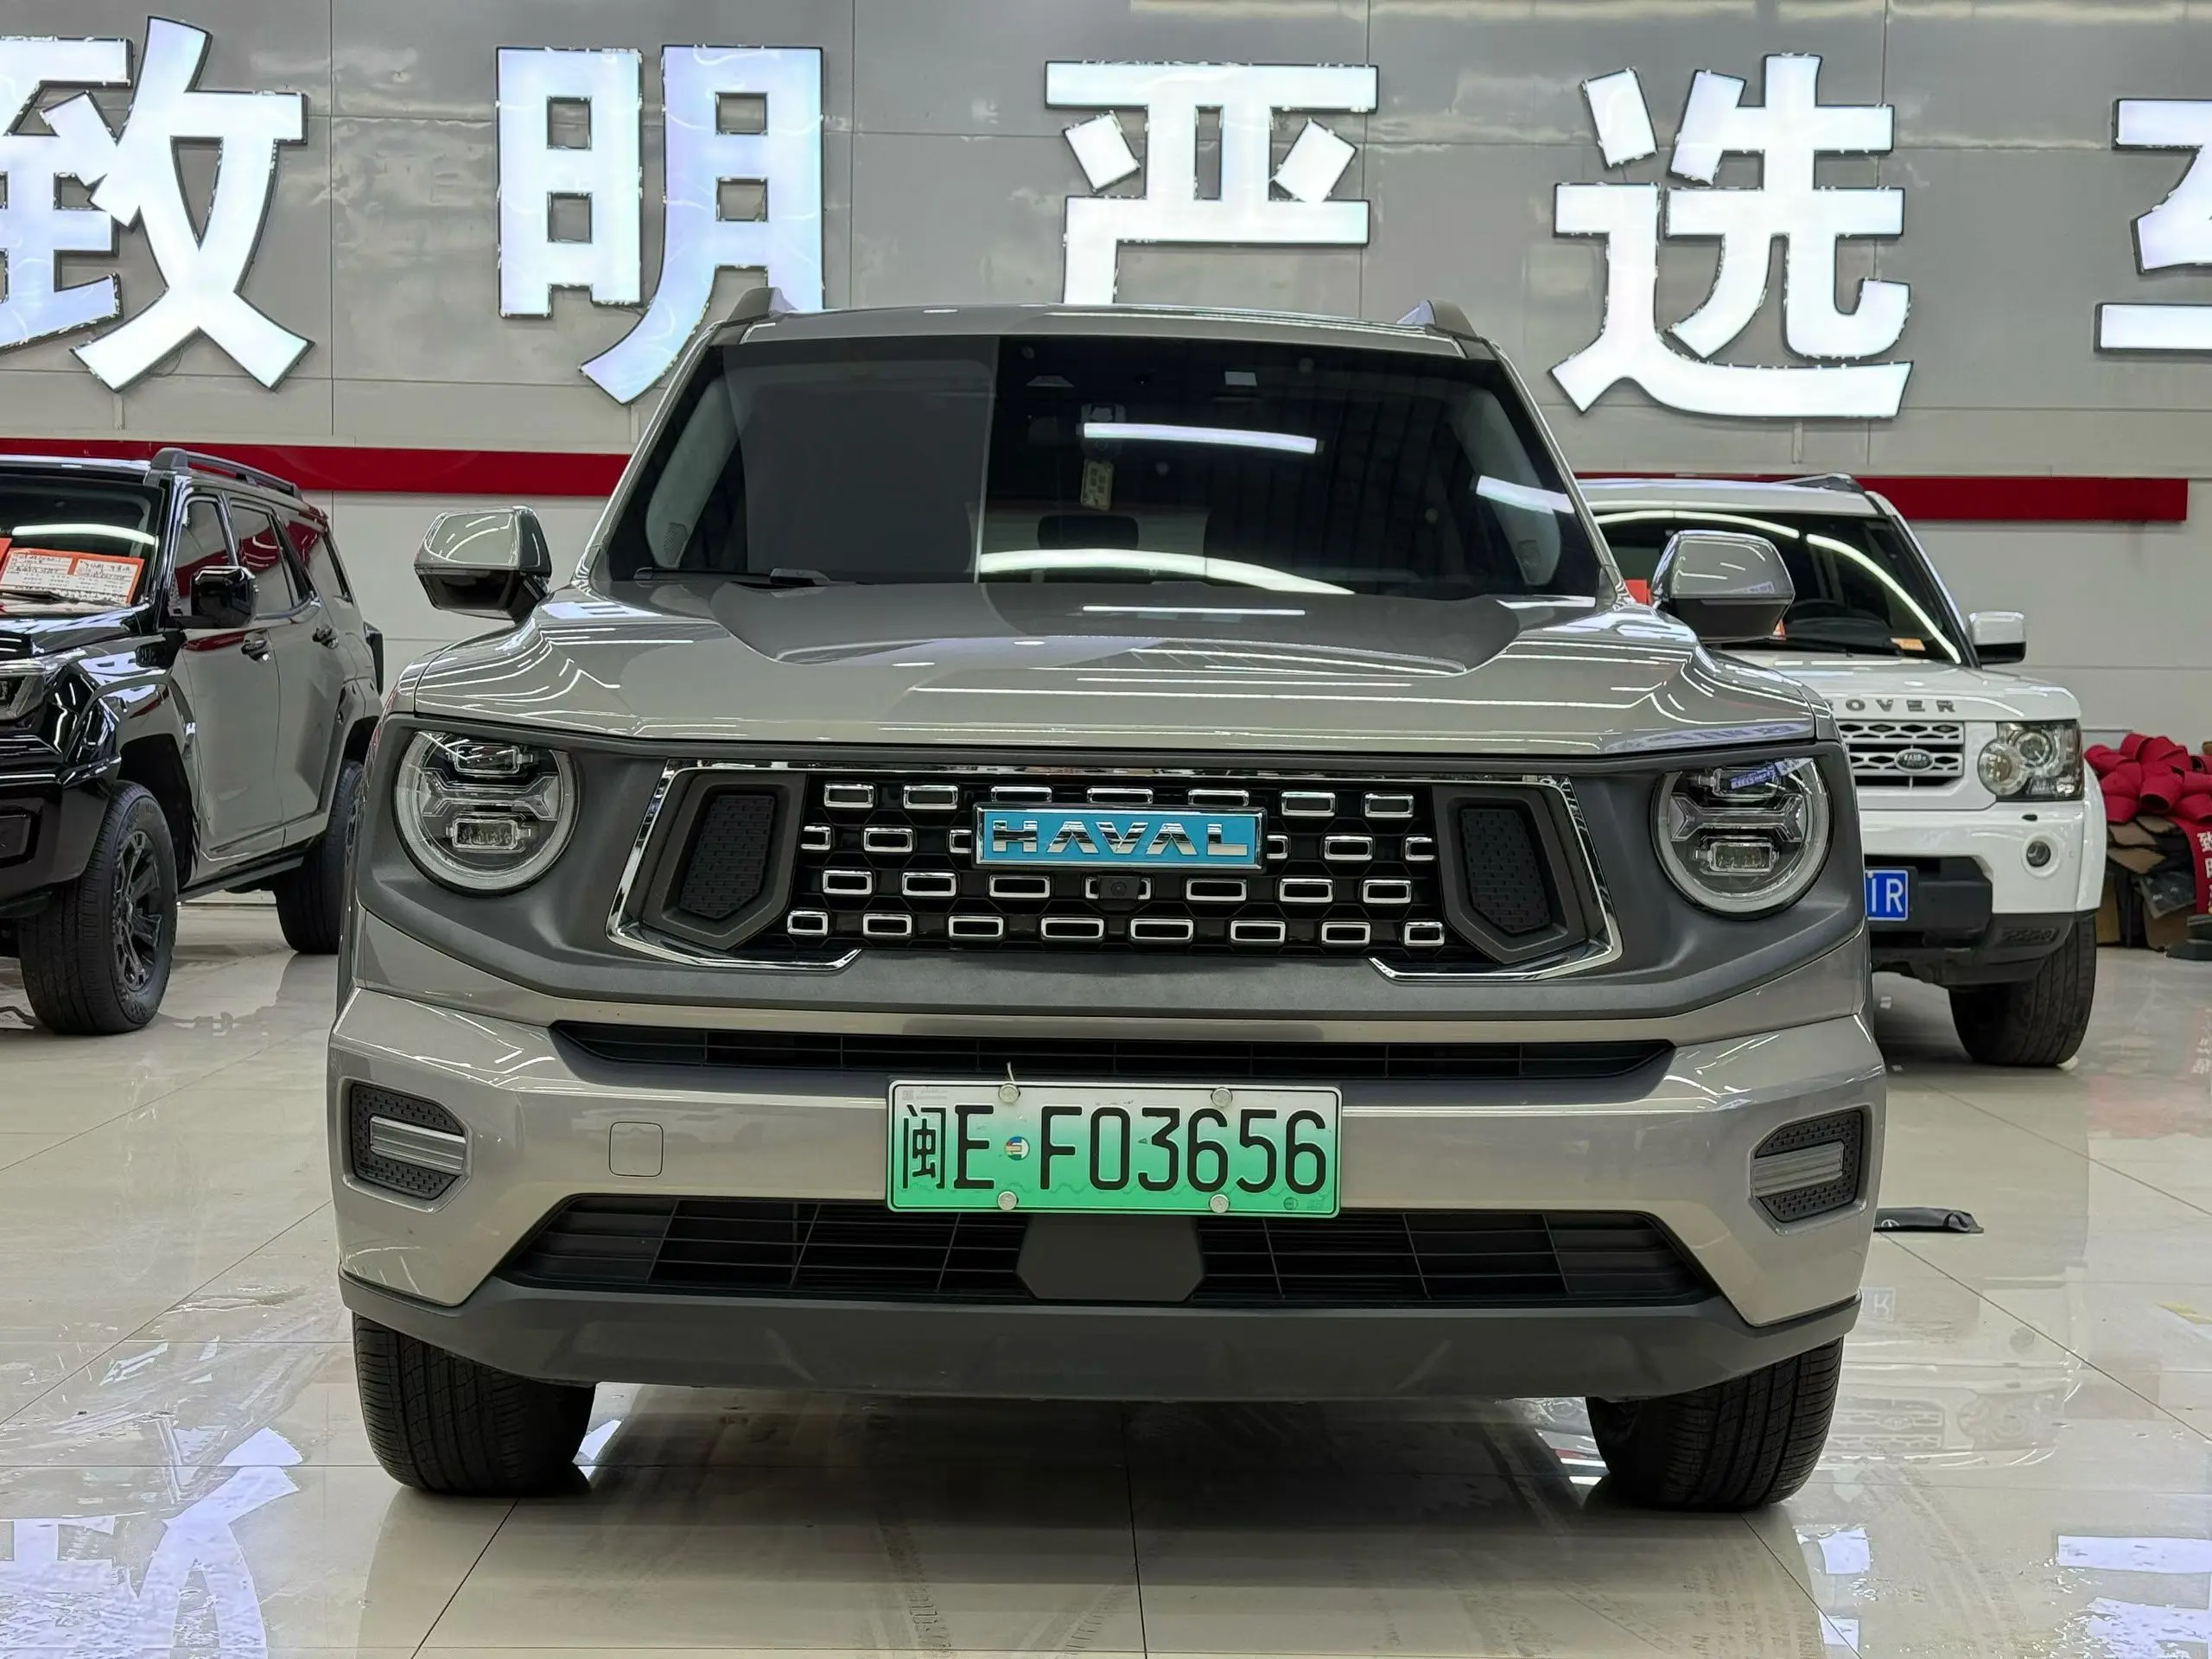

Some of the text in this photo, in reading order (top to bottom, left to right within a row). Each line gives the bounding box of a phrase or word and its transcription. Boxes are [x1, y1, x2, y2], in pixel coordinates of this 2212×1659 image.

[1826, 698, 1956, 713] OVER
[991, 819, 1249, 857] HAVAL
[1039, 1106, 1327, 1195] F03656
